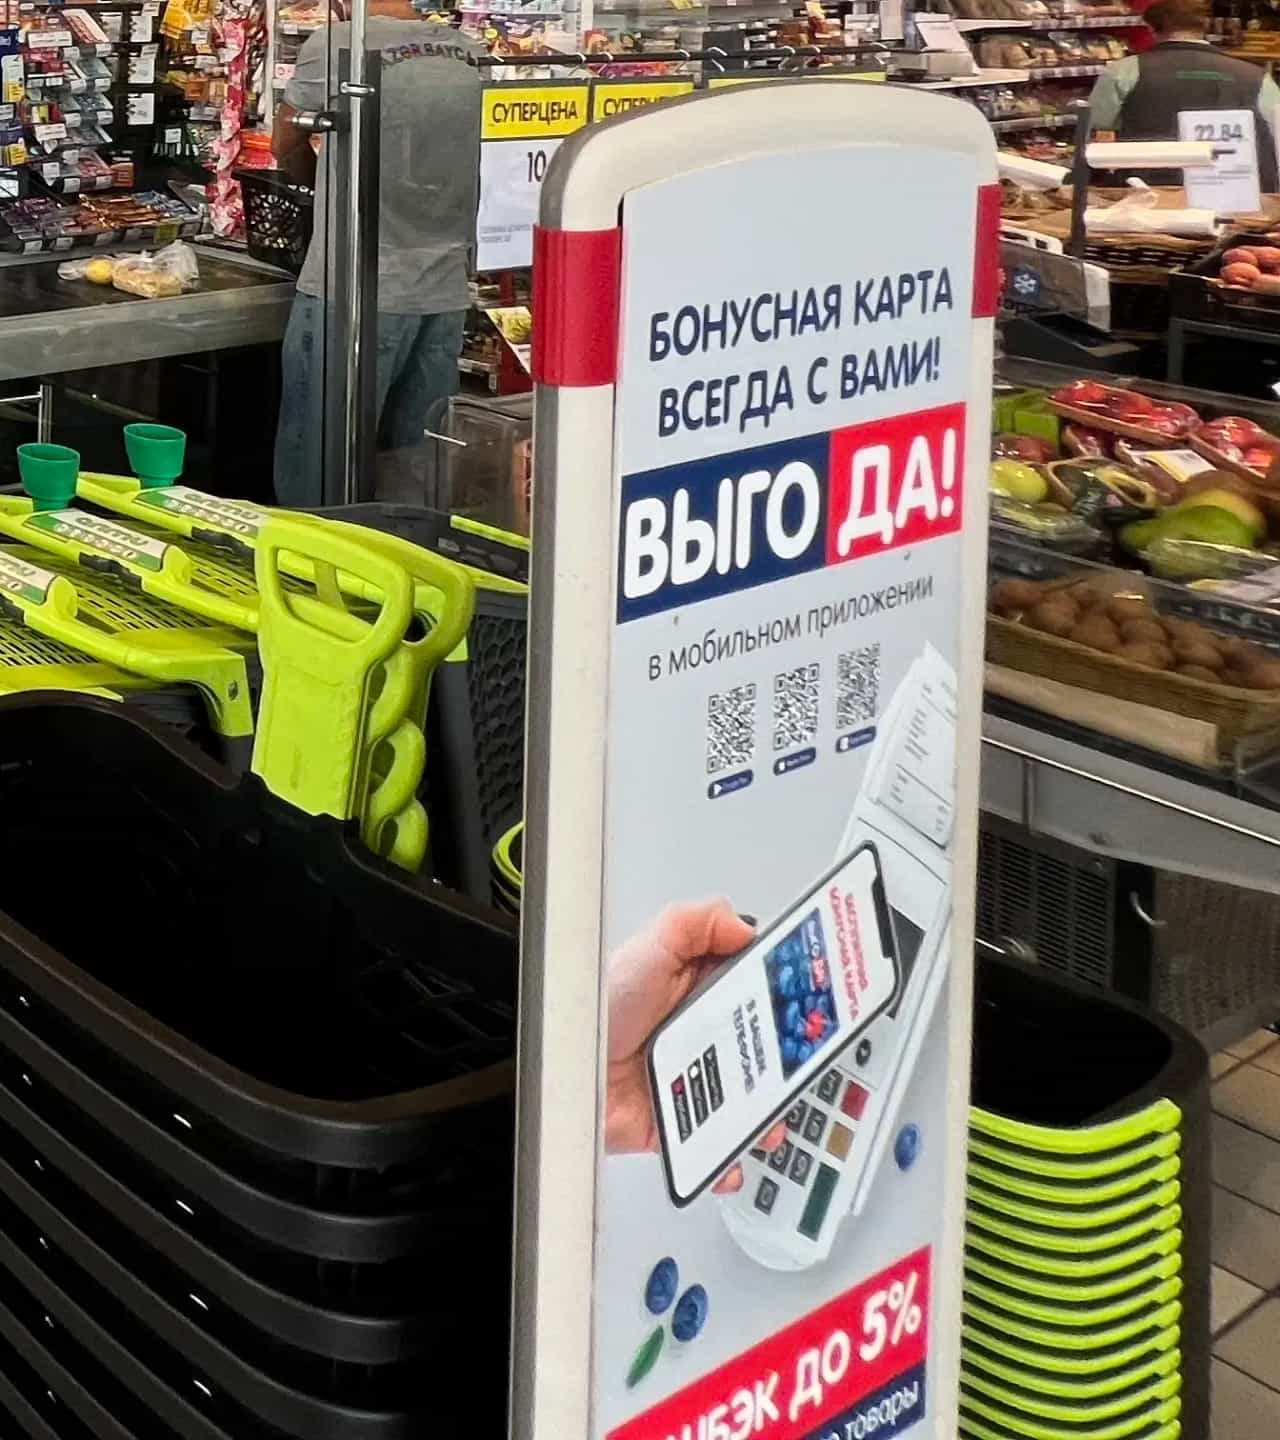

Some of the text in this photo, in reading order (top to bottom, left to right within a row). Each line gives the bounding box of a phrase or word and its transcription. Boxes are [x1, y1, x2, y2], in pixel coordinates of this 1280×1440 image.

[492, 101, 578, 125] СУПЕРЦЕНА
[650, 267, 952, 361] БОНУСНАЯ КАРТА
[658, 336, 940, 437] ВСЕГДА С ВАМИ!
[623, 427, 956, 600] ВЫГО ДА!
[648, 575, 934, 681] в мобильном приложении
[789, 1331, 850, 1422] ДО
[859, 1271, 922, 1361] 5%
[844, 1381, 920, 1440] товары
